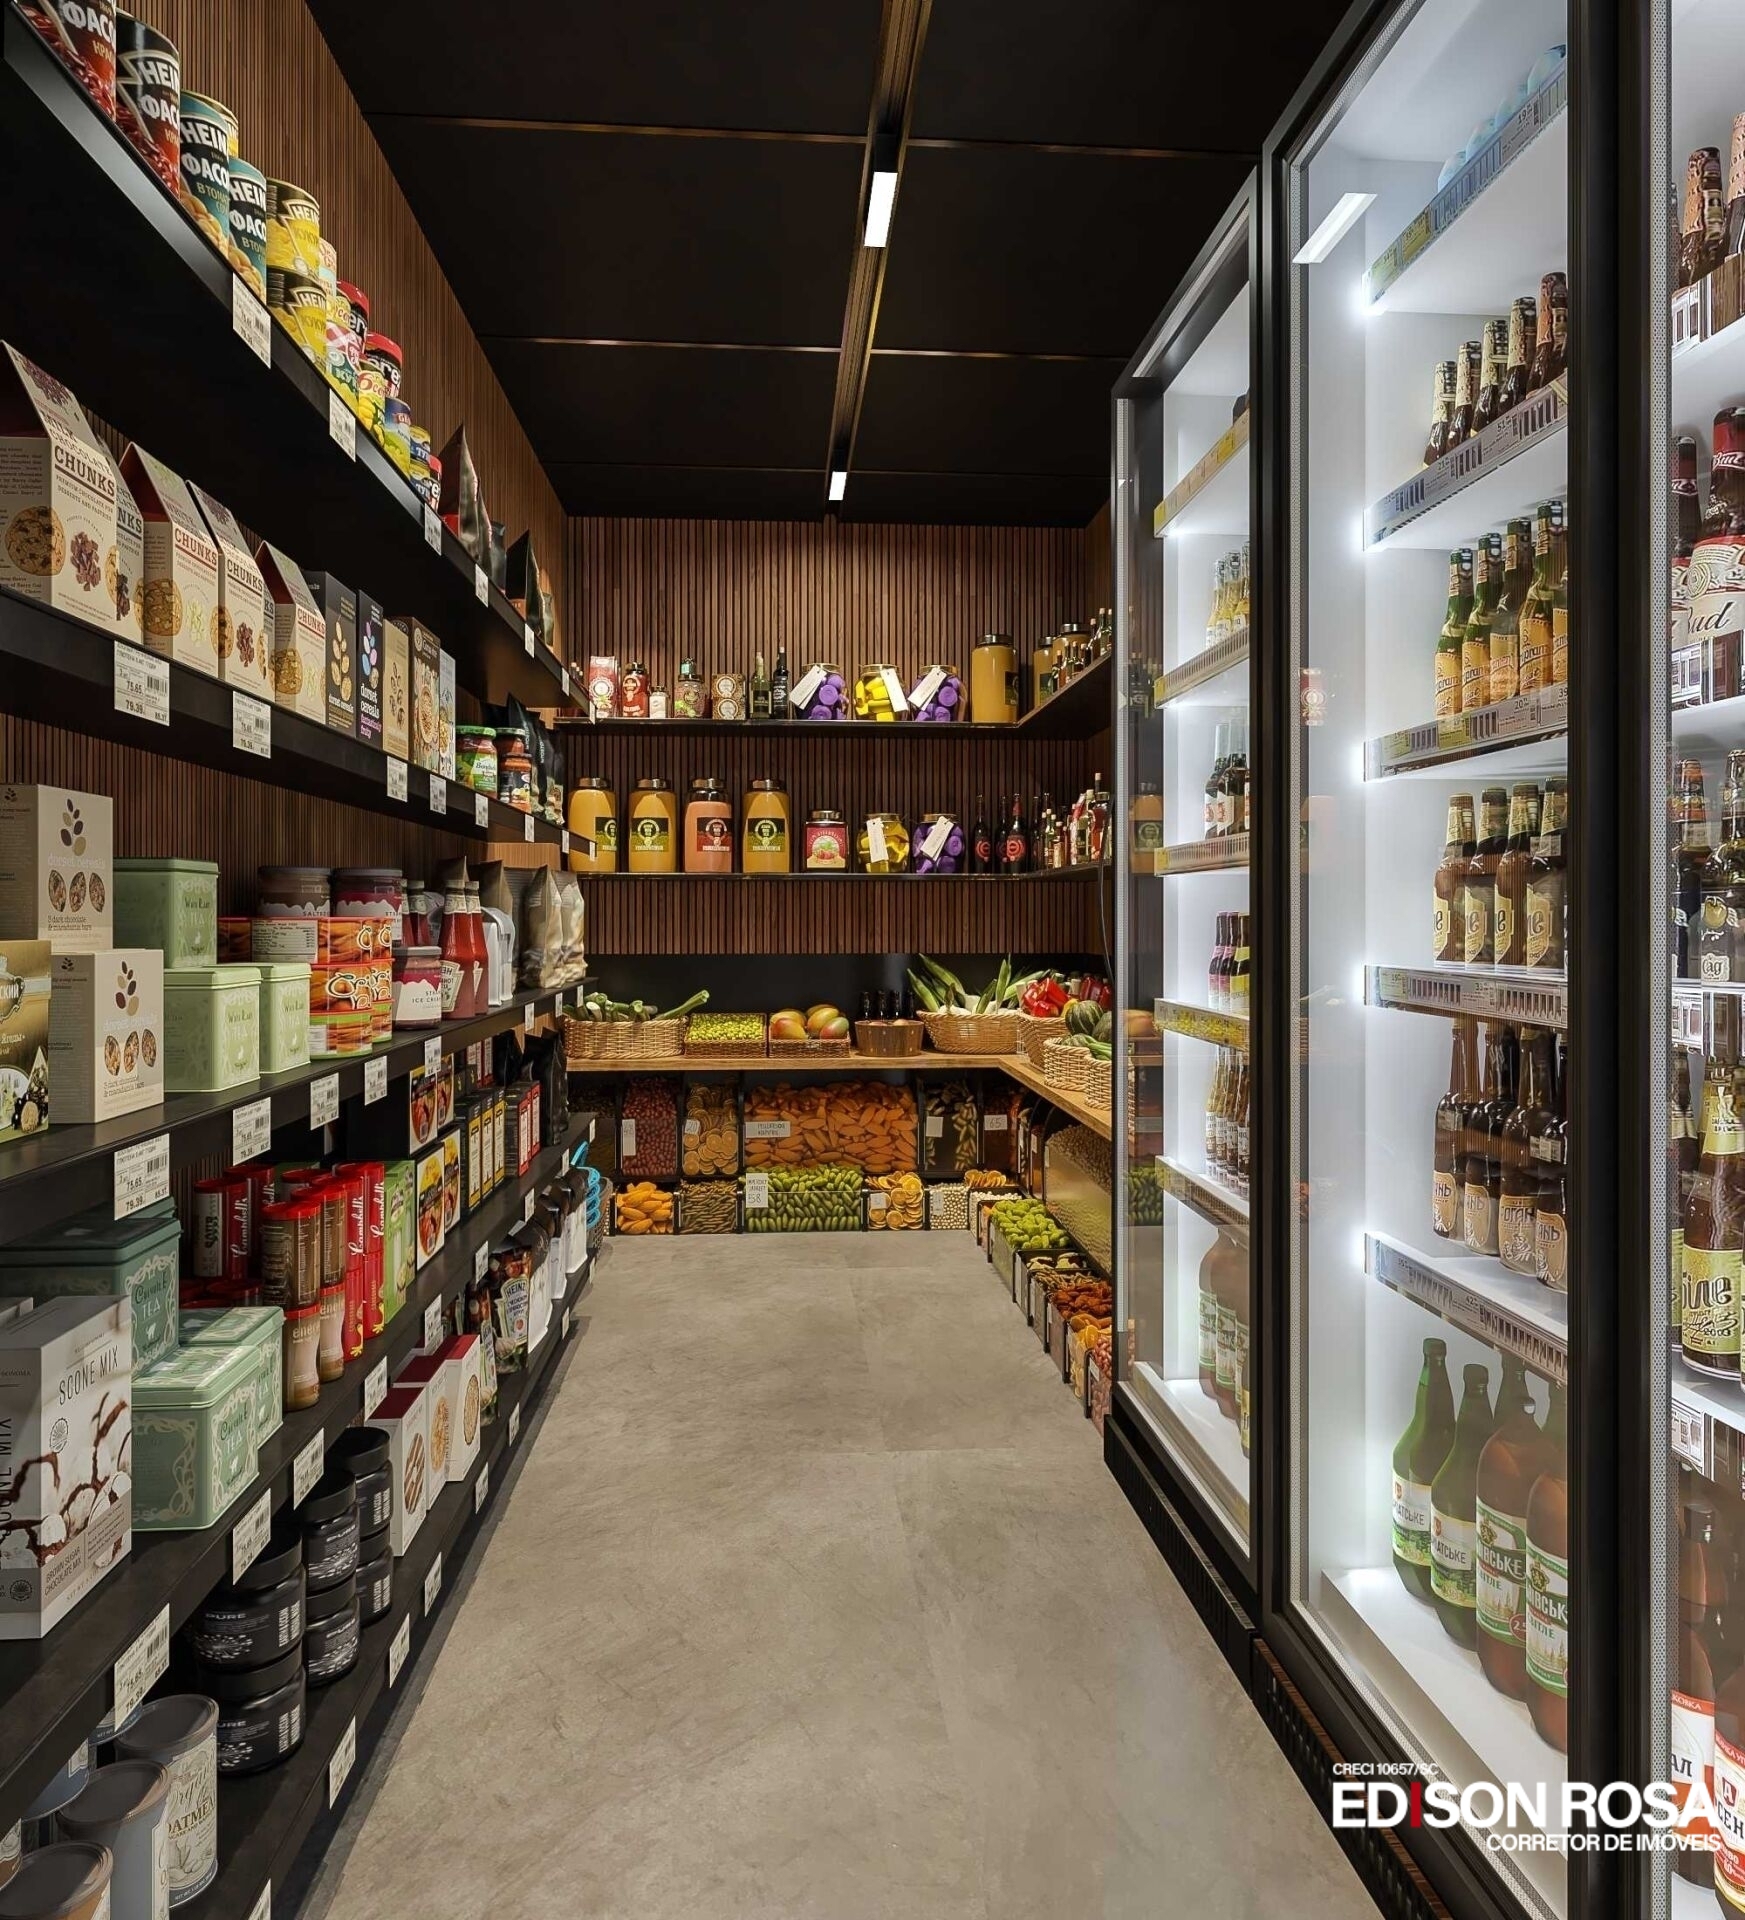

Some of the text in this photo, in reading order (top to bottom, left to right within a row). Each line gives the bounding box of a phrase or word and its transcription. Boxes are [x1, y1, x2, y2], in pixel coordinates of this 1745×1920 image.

[55, 445, 115, 497] CHUNKS
[174, 528, 218, 566] CHUNKS
[227, 559, 263, 592] CHUNKS
[126, 1176, 143, 1192] 75.65
[125, 1195, 144, 1212] 79.39
[58, 1345, 119, 1406] SCONE MIX
[44, 1567, 73, 1596] CHOCOLATE
[46, 1562, 65, 1584] BROWN
[206, 1612, 247, 1620] PURE
